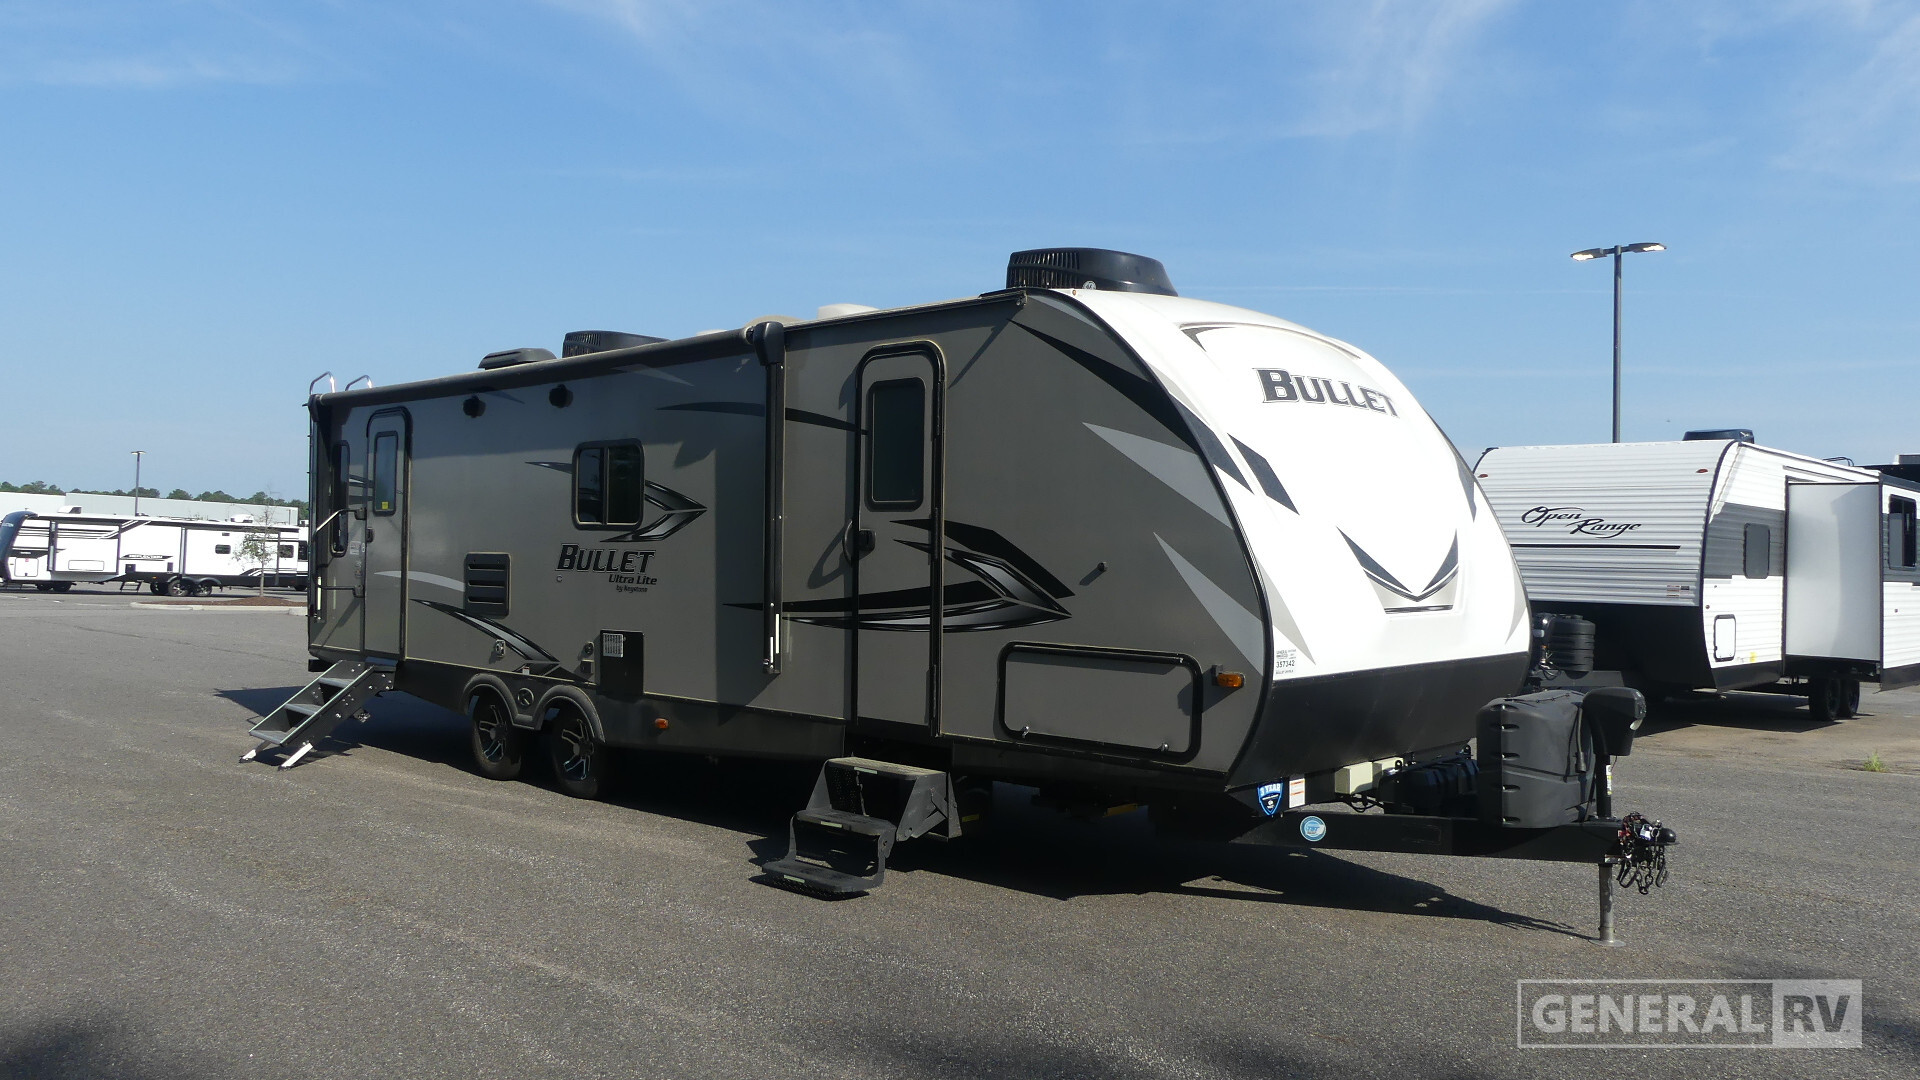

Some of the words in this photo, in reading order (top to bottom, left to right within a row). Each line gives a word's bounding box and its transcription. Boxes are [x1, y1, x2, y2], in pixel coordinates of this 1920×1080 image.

[1252, 368, 1399, 418] BULLET
[1522, 506, 1585, 527] Open
[1565, 519, 1642, 538] Range
[555, 544, 656, 574] BULLET
[609, 574, 634, 584] Ultra
[636, 575, 657, 585] Lite
